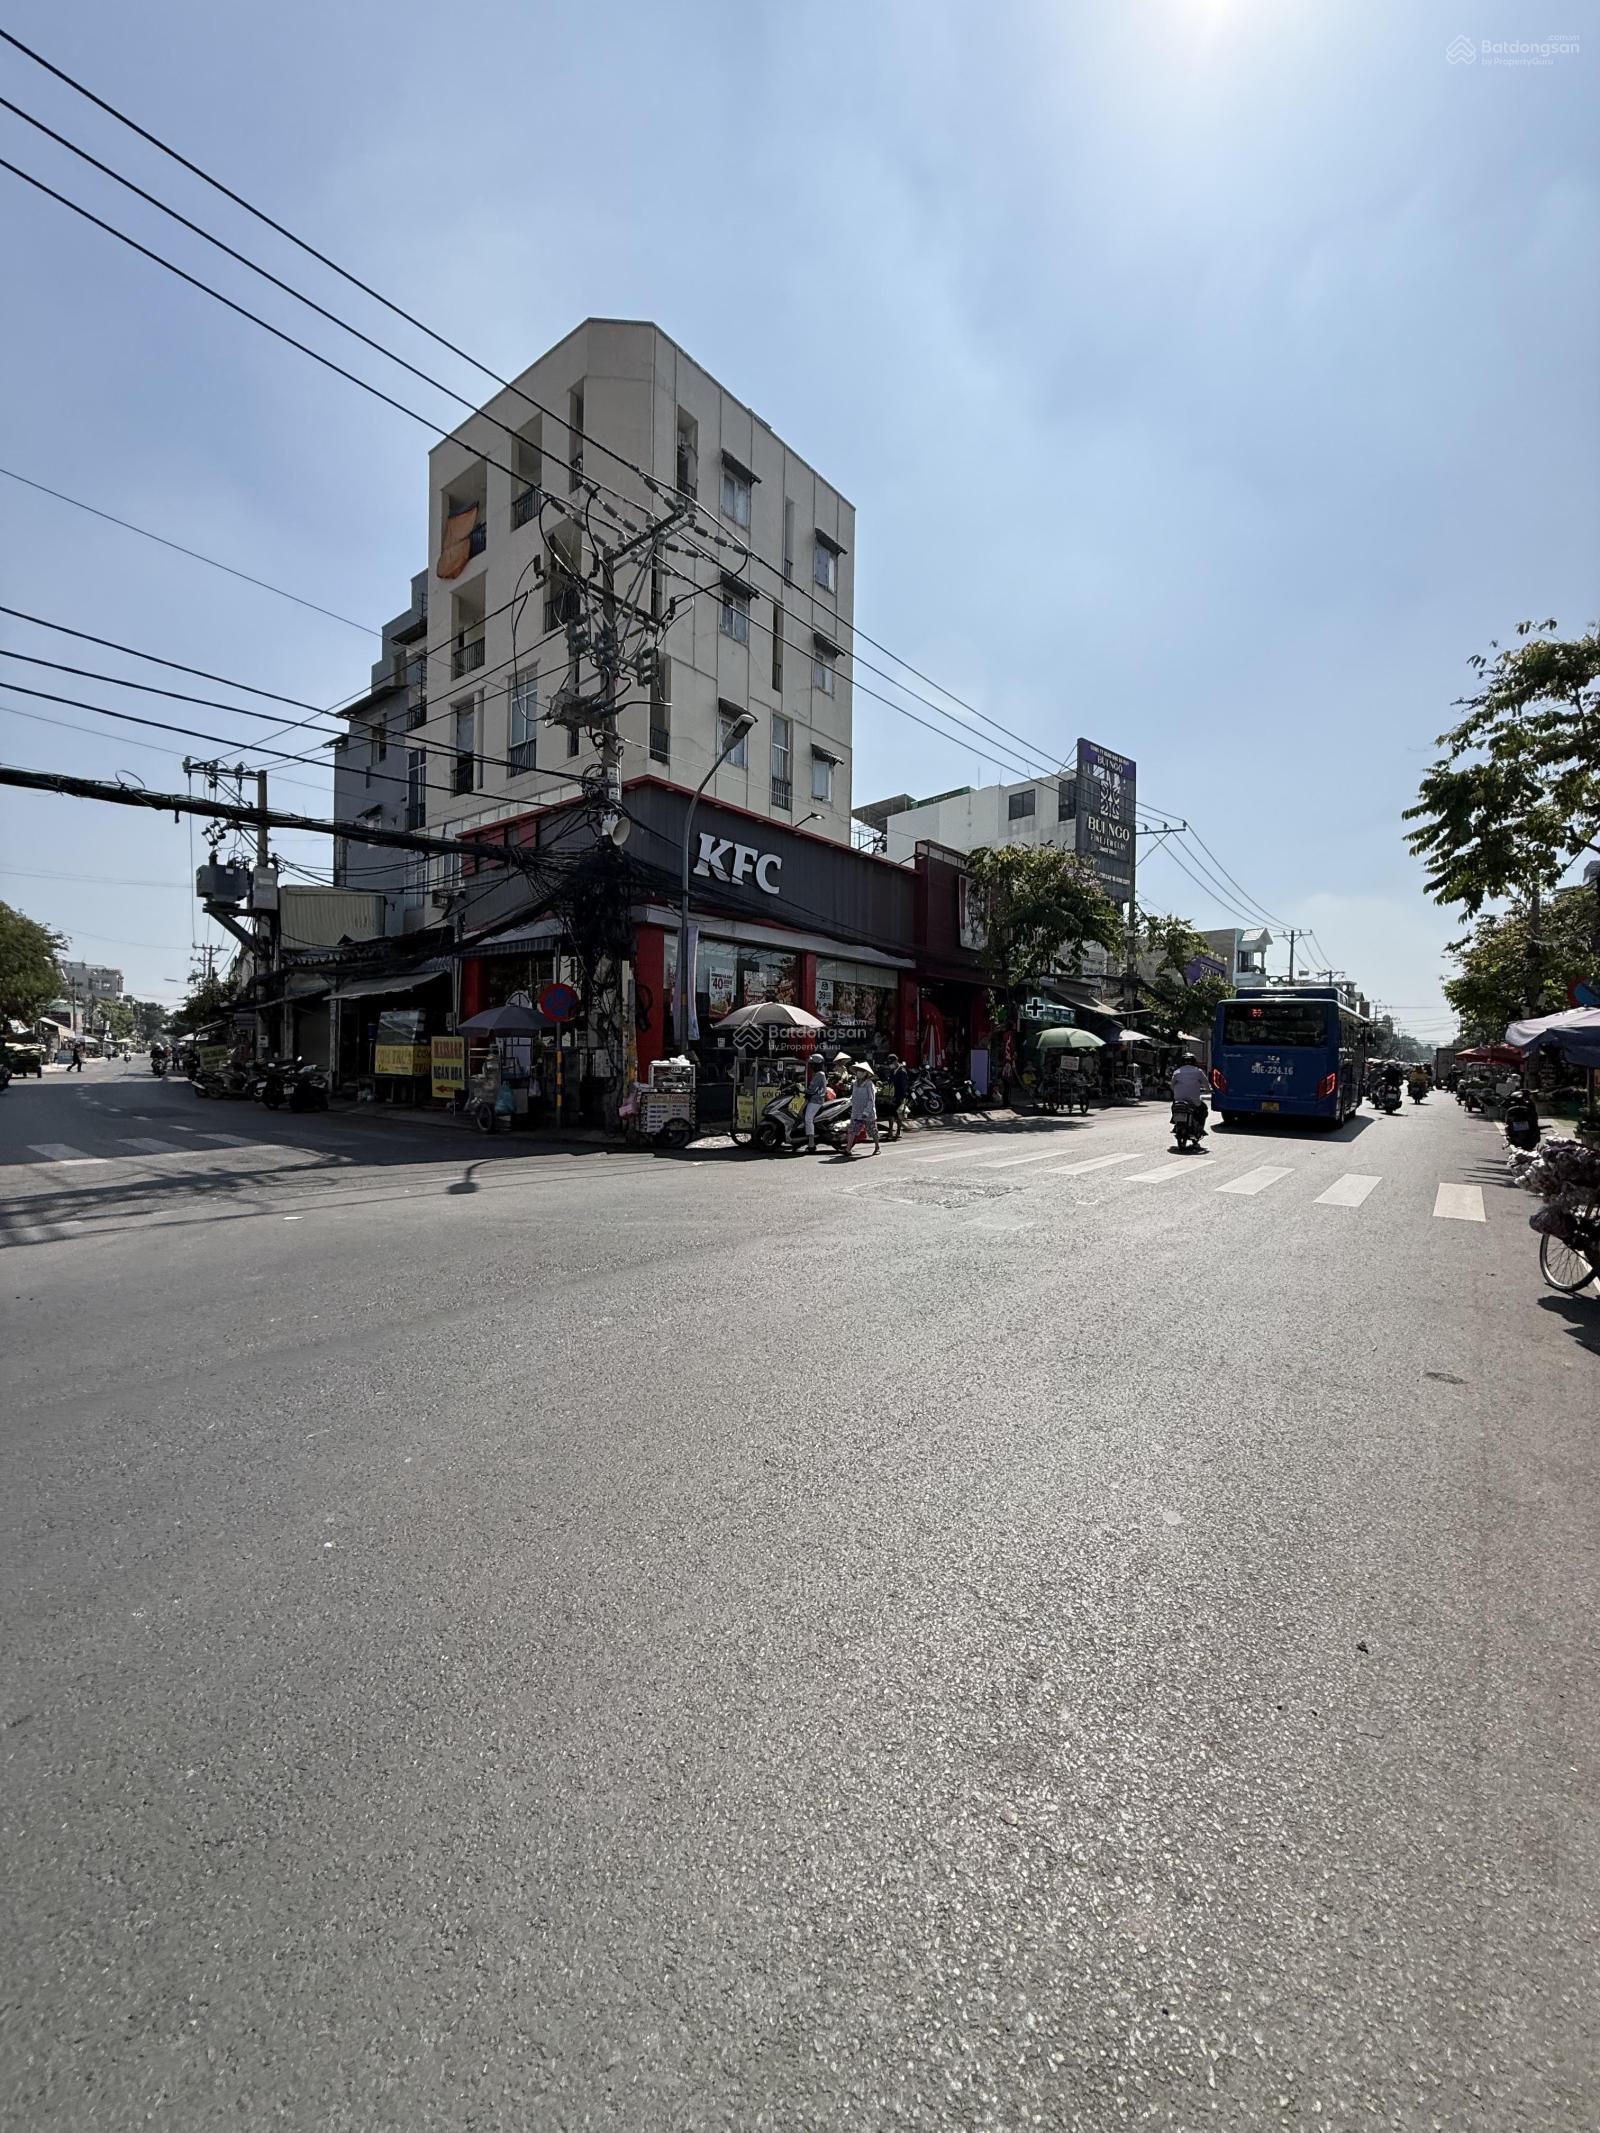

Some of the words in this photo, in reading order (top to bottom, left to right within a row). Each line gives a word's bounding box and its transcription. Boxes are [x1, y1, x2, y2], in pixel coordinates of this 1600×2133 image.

[1088, 815, 1105, 834] BÙI
[693, 832, 782, 895] KFC
[712, 977, 723, 990] 40
